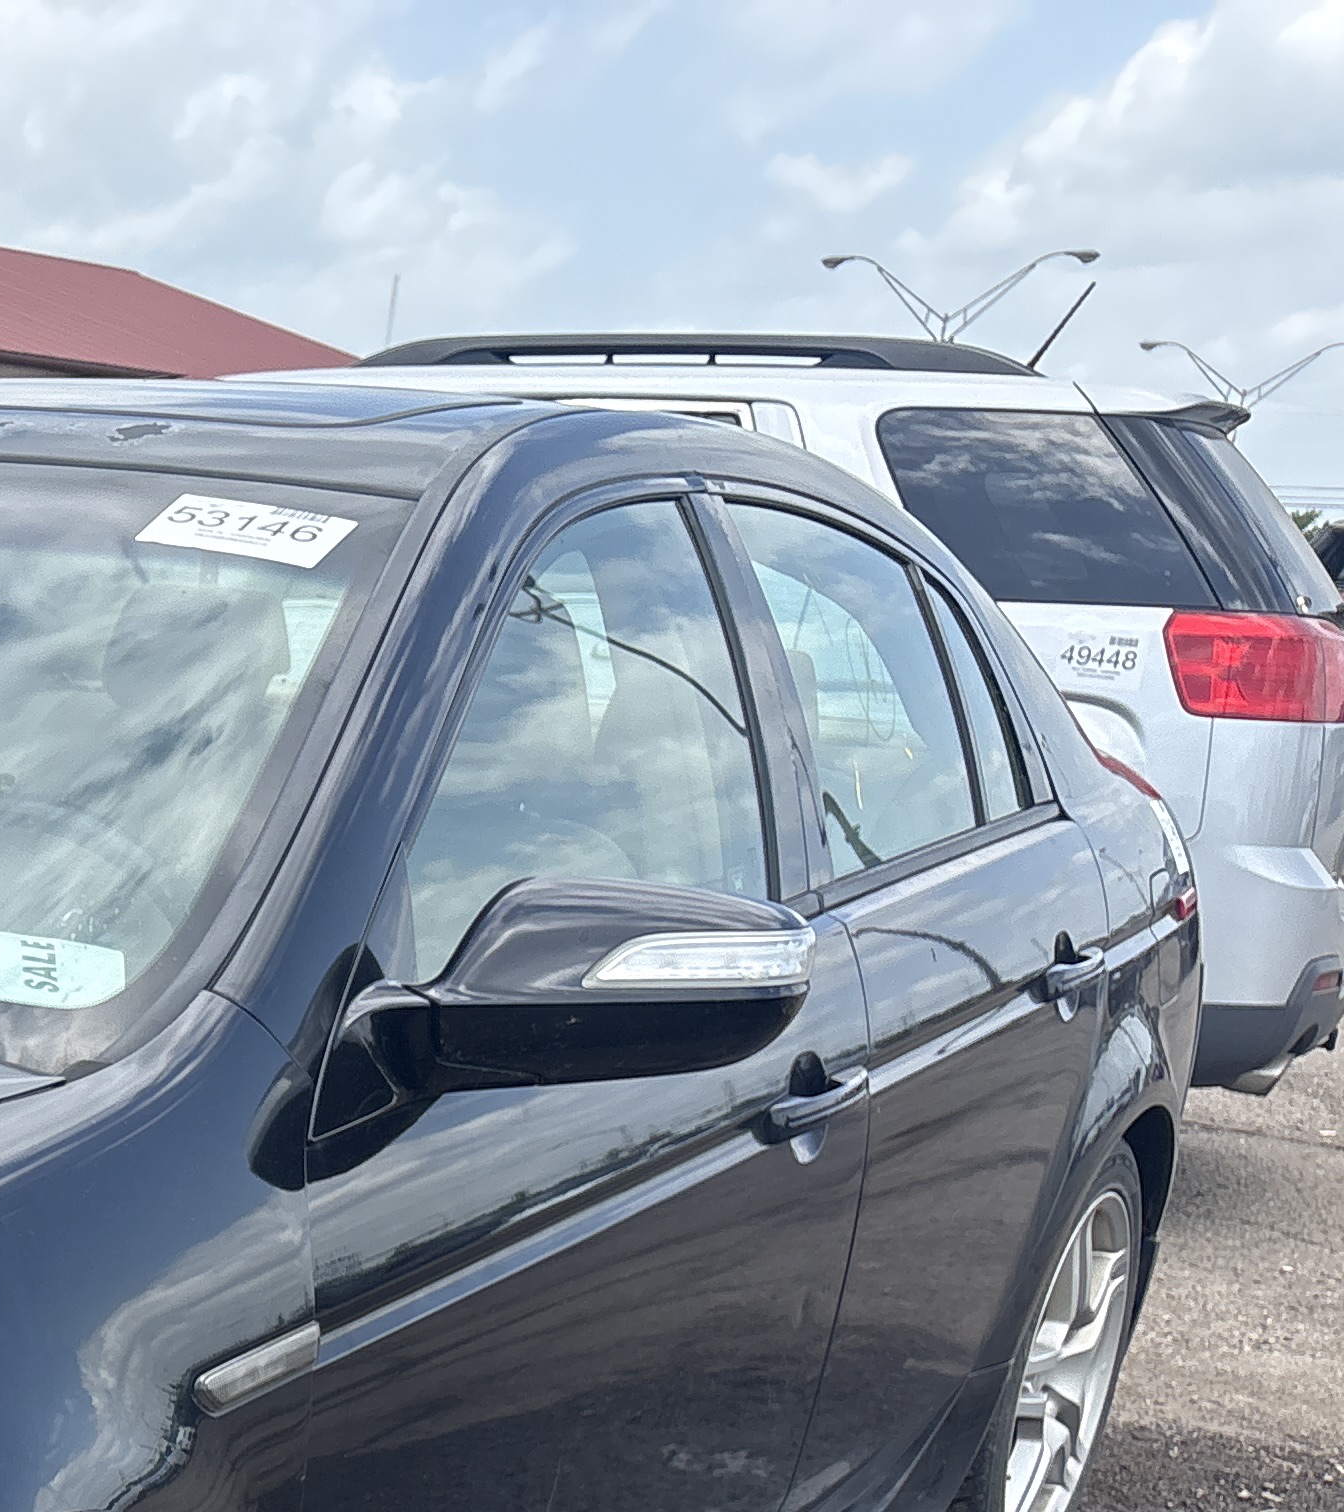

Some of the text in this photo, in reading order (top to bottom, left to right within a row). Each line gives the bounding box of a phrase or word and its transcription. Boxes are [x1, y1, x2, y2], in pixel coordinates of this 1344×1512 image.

[167, 505, 323, 543] 53146
[1060, 644, 1138, 671] 49448
[20, 938, 60, 993] SALE
